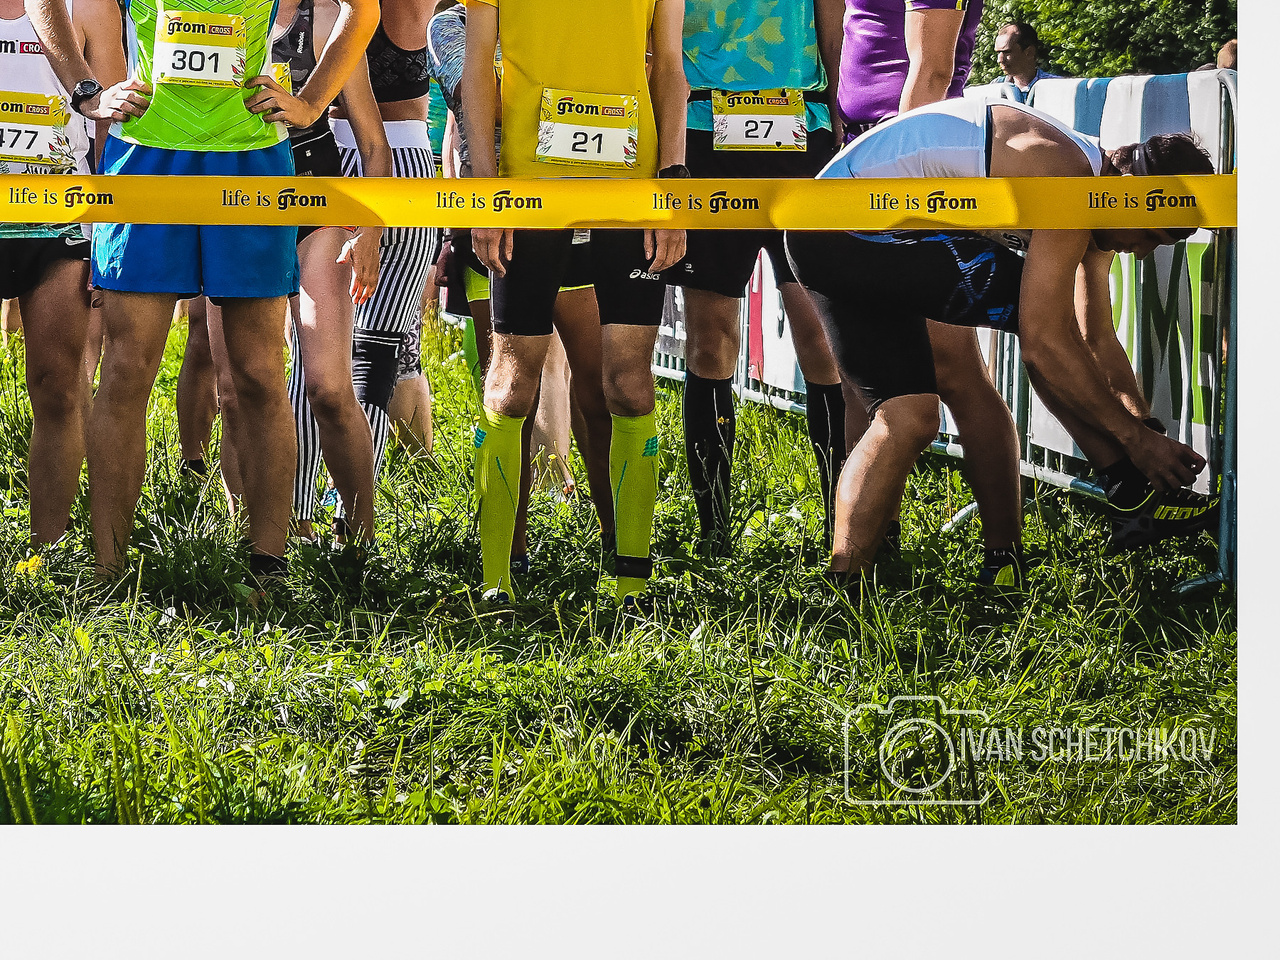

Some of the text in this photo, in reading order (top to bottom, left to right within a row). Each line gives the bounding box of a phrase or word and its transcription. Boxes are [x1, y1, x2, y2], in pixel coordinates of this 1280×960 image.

[167, 16, 231, 35] grom CROSS
[23, 43, 45, 53] CRO
[171, 49, 220, 73] 301
[28, 105, 49, 114] CROSS
[556, 96, 600, 115] grom
[726, 91, 765, 108] grom
[744, 119, 774, 140] 27
[571, 131, 604, 154] 21
[9, 185, 114, 208] life is grom
[221, 188, 327, 211] life is grom
[436, 190, 543, 213] life is grom
[652, 190, 760, 214] life is grom
[869, 190, 978, 212] life is grom
[1088, 188, 1197, 212] life is grom
